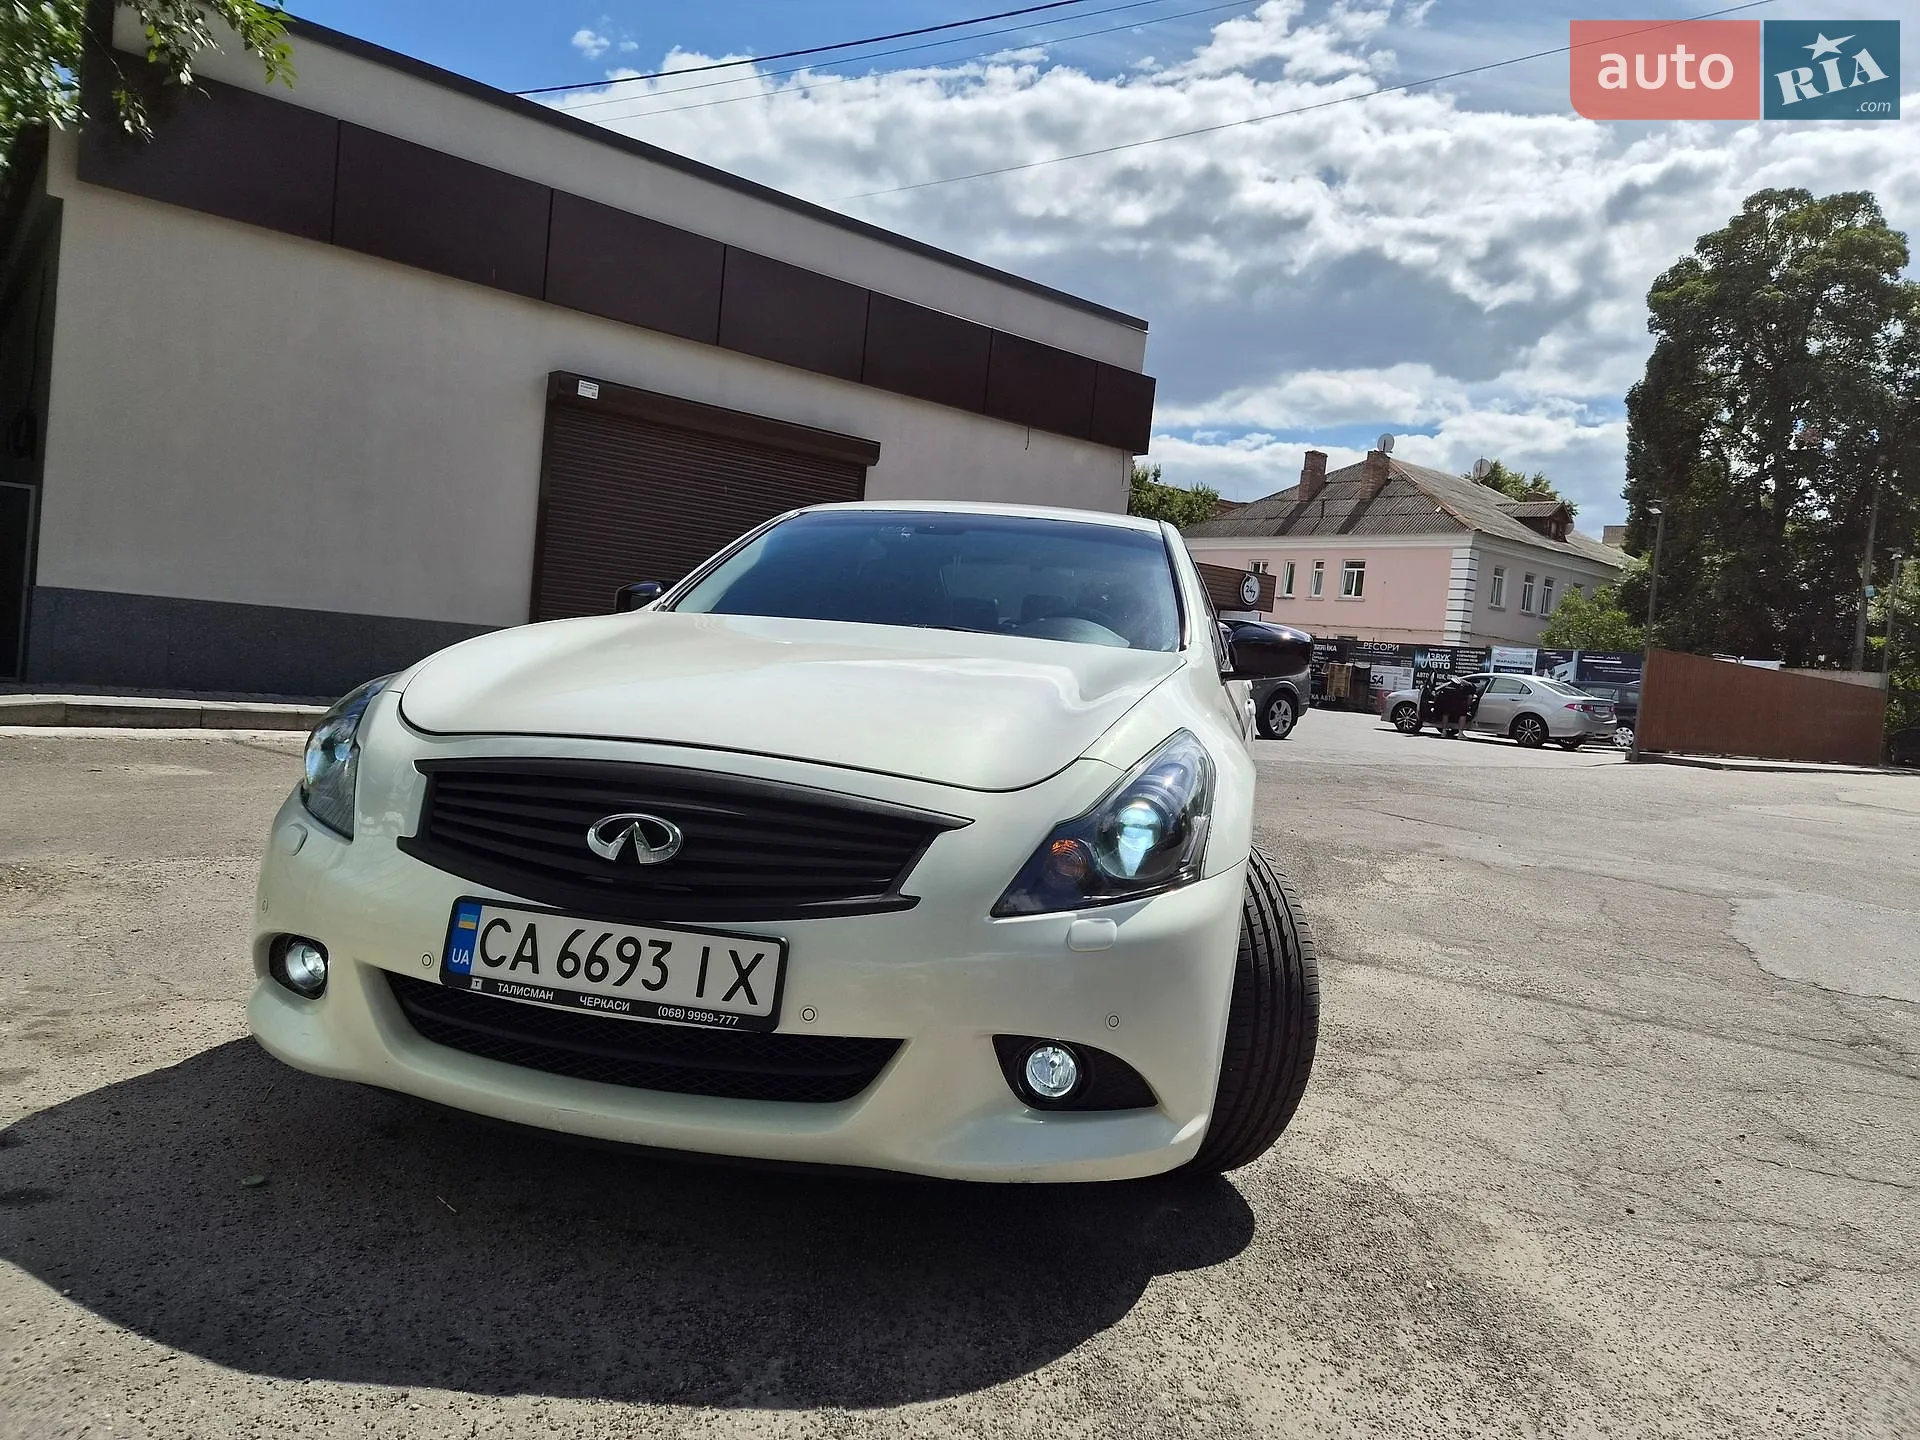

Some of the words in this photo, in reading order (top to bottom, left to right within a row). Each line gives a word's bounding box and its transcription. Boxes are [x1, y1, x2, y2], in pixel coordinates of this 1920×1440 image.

[1363, 642, 1399, 651] РЕСОРИ
[451, 948, 470, 966] UA
[556, 928, 673, 992] 6693
[497, 983, 554, 1001] ТАЛИСМАН
[579, 995, 630, 1012] ЧЕРКАСИ
[657, 1005, 685, 1020] (068)
[687, 1010, 740, 1026] 9999-777
